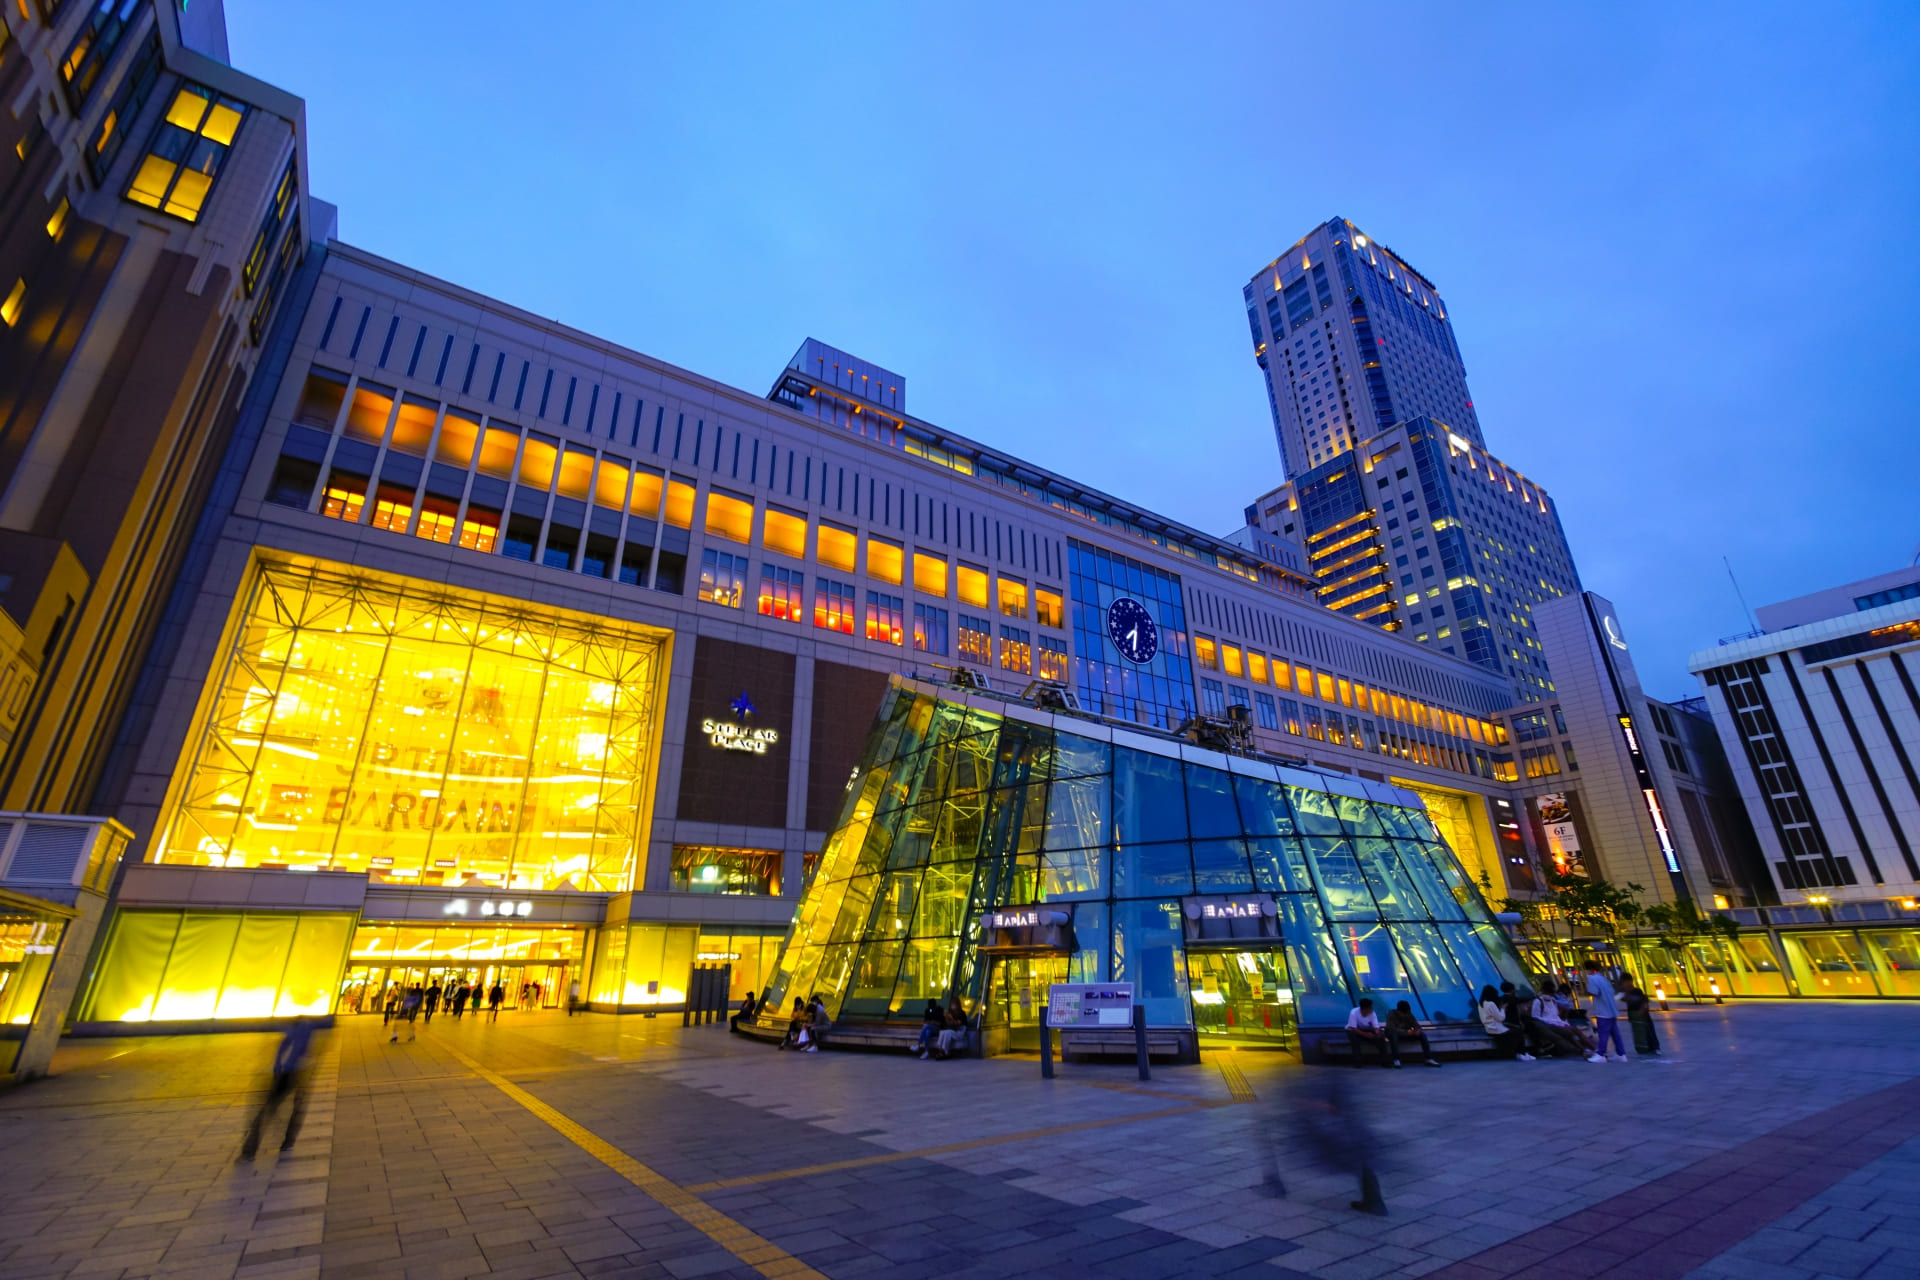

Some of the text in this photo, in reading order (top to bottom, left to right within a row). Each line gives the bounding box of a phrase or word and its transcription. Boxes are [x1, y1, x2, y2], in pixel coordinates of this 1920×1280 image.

[702, 719, 778, 742] STELLAR
[711, 733, 767, 753] PLACE
[322, 786, 514, 833] BARGAIN
[1553, 826, 1567, 836] 6F
